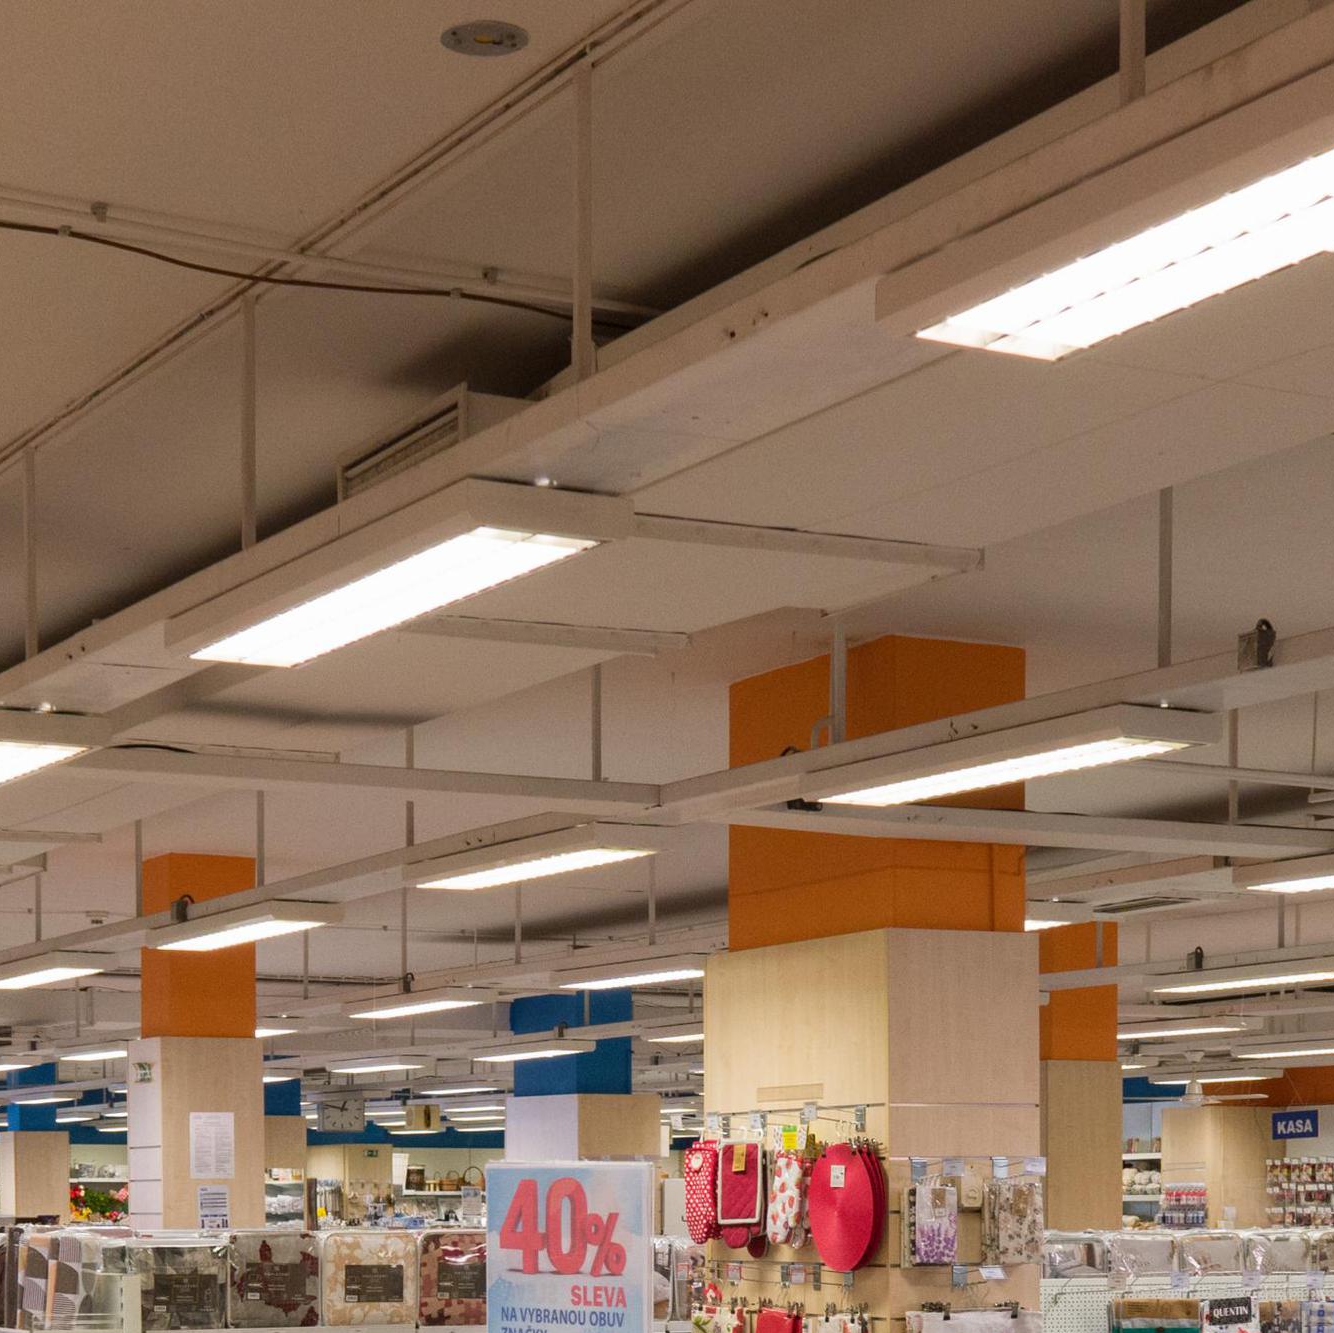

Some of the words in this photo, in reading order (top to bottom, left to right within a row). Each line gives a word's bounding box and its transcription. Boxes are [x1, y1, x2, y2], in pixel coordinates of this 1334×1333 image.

[1277, 1118, 1313, 1135] KASA
[499, 1178, 627, 1277] 40%
[570, 1285, 627, 1308] SLEVA
[501, 1307, 516, 1321] NA
[520, 1308, 586, 1325] VYBRANOU
[589, 1311, 625, 1327] OBUV
[1213, 1306, 1248, 1318] QUENTIN
